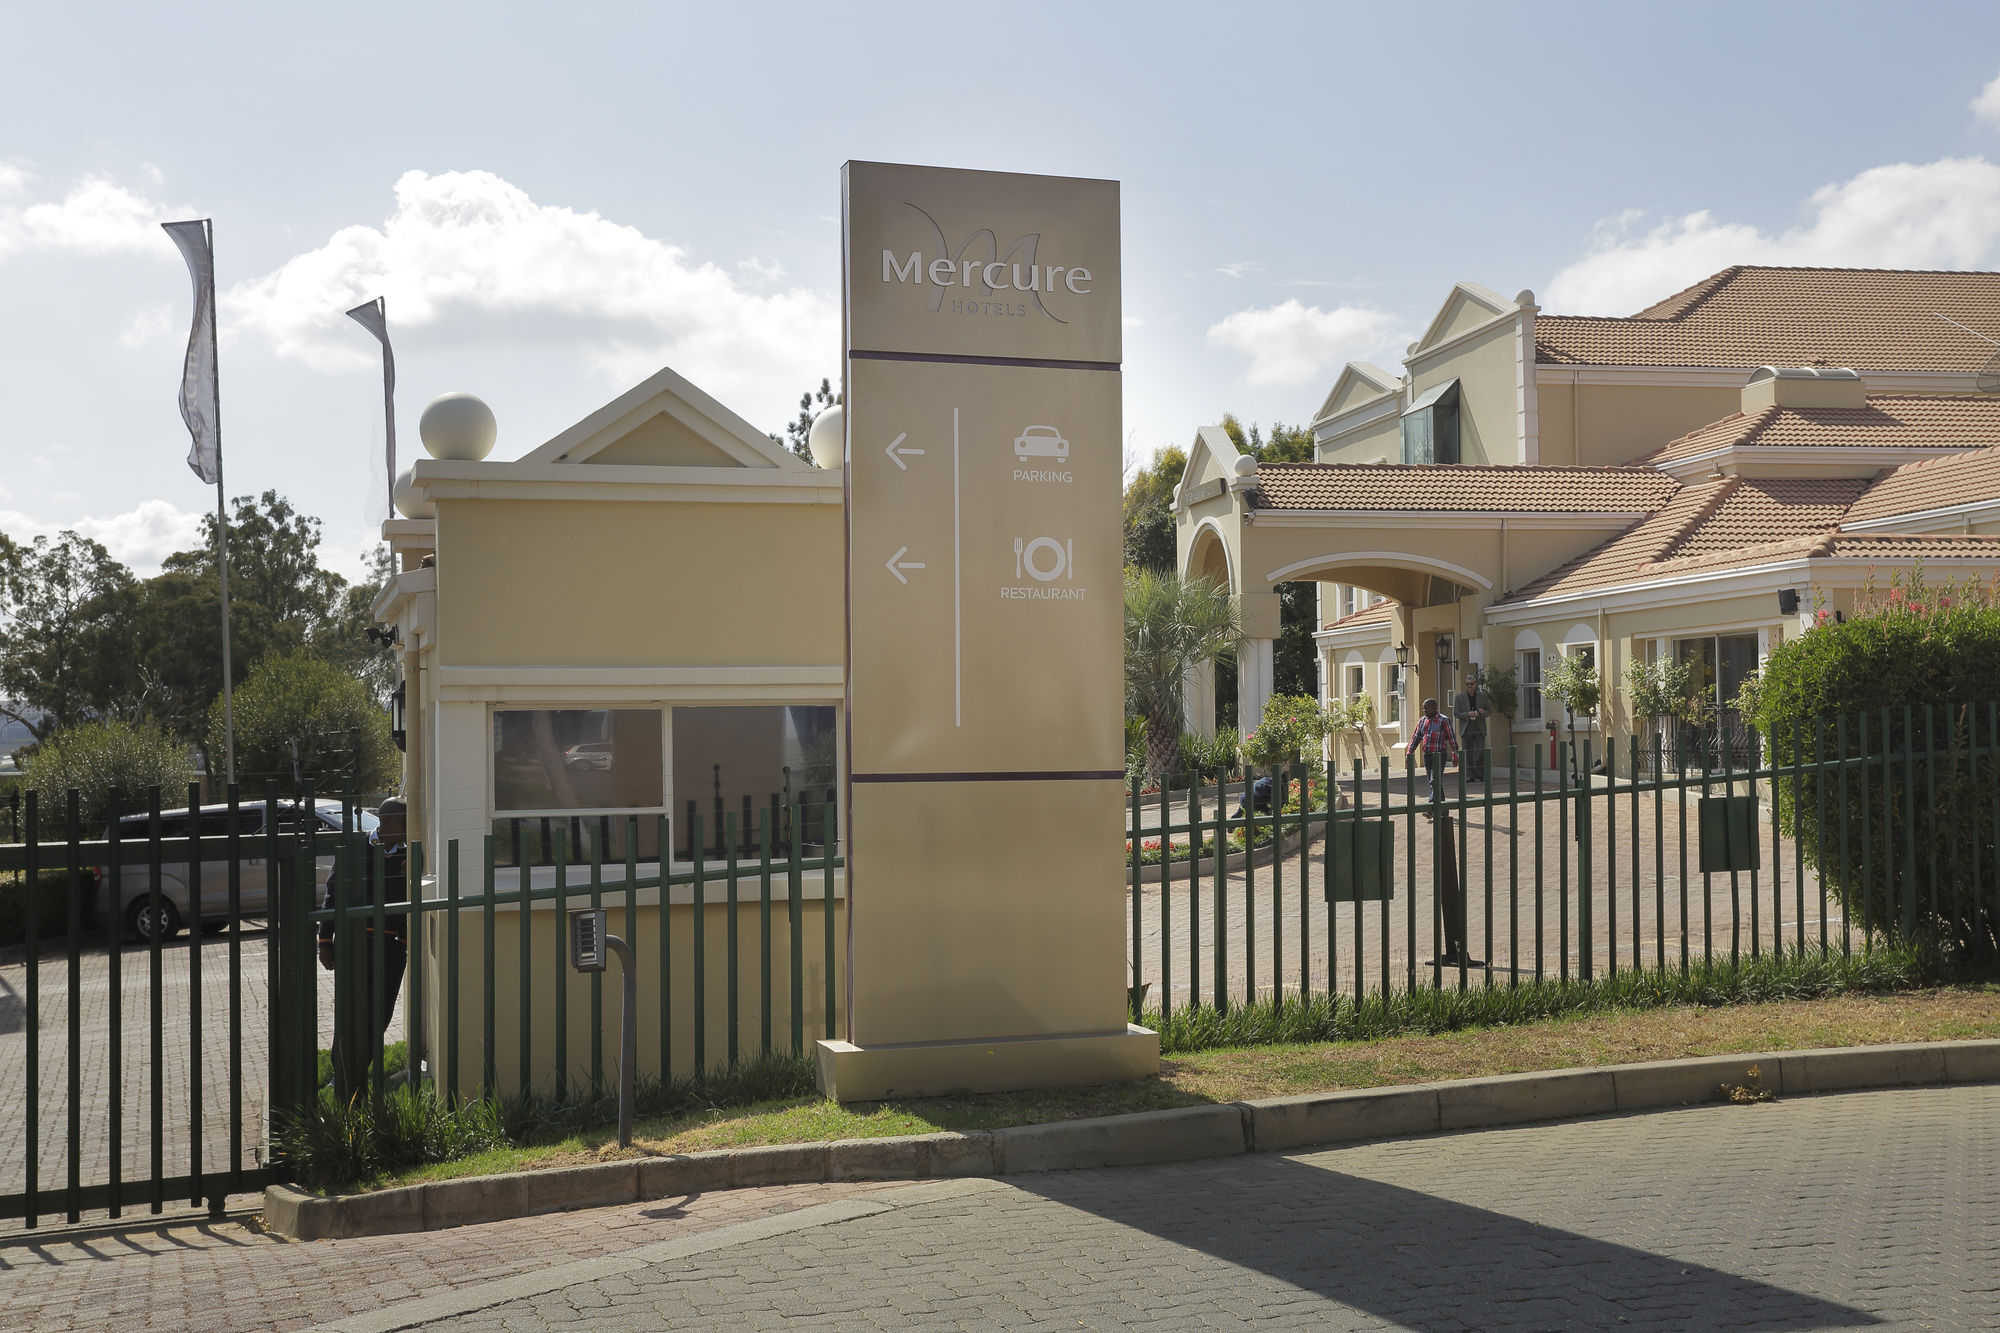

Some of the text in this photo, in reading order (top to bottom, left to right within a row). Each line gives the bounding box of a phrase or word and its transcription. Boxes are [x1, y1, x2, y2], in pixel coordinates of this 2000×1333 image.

[881, 249, 1093, 295] Mercure
[951, 300, 1027, 318] HOTELS
[1012, 469, 1073, 483] PARKING
[1000, 586, 1088, 601] RESTAURANT
